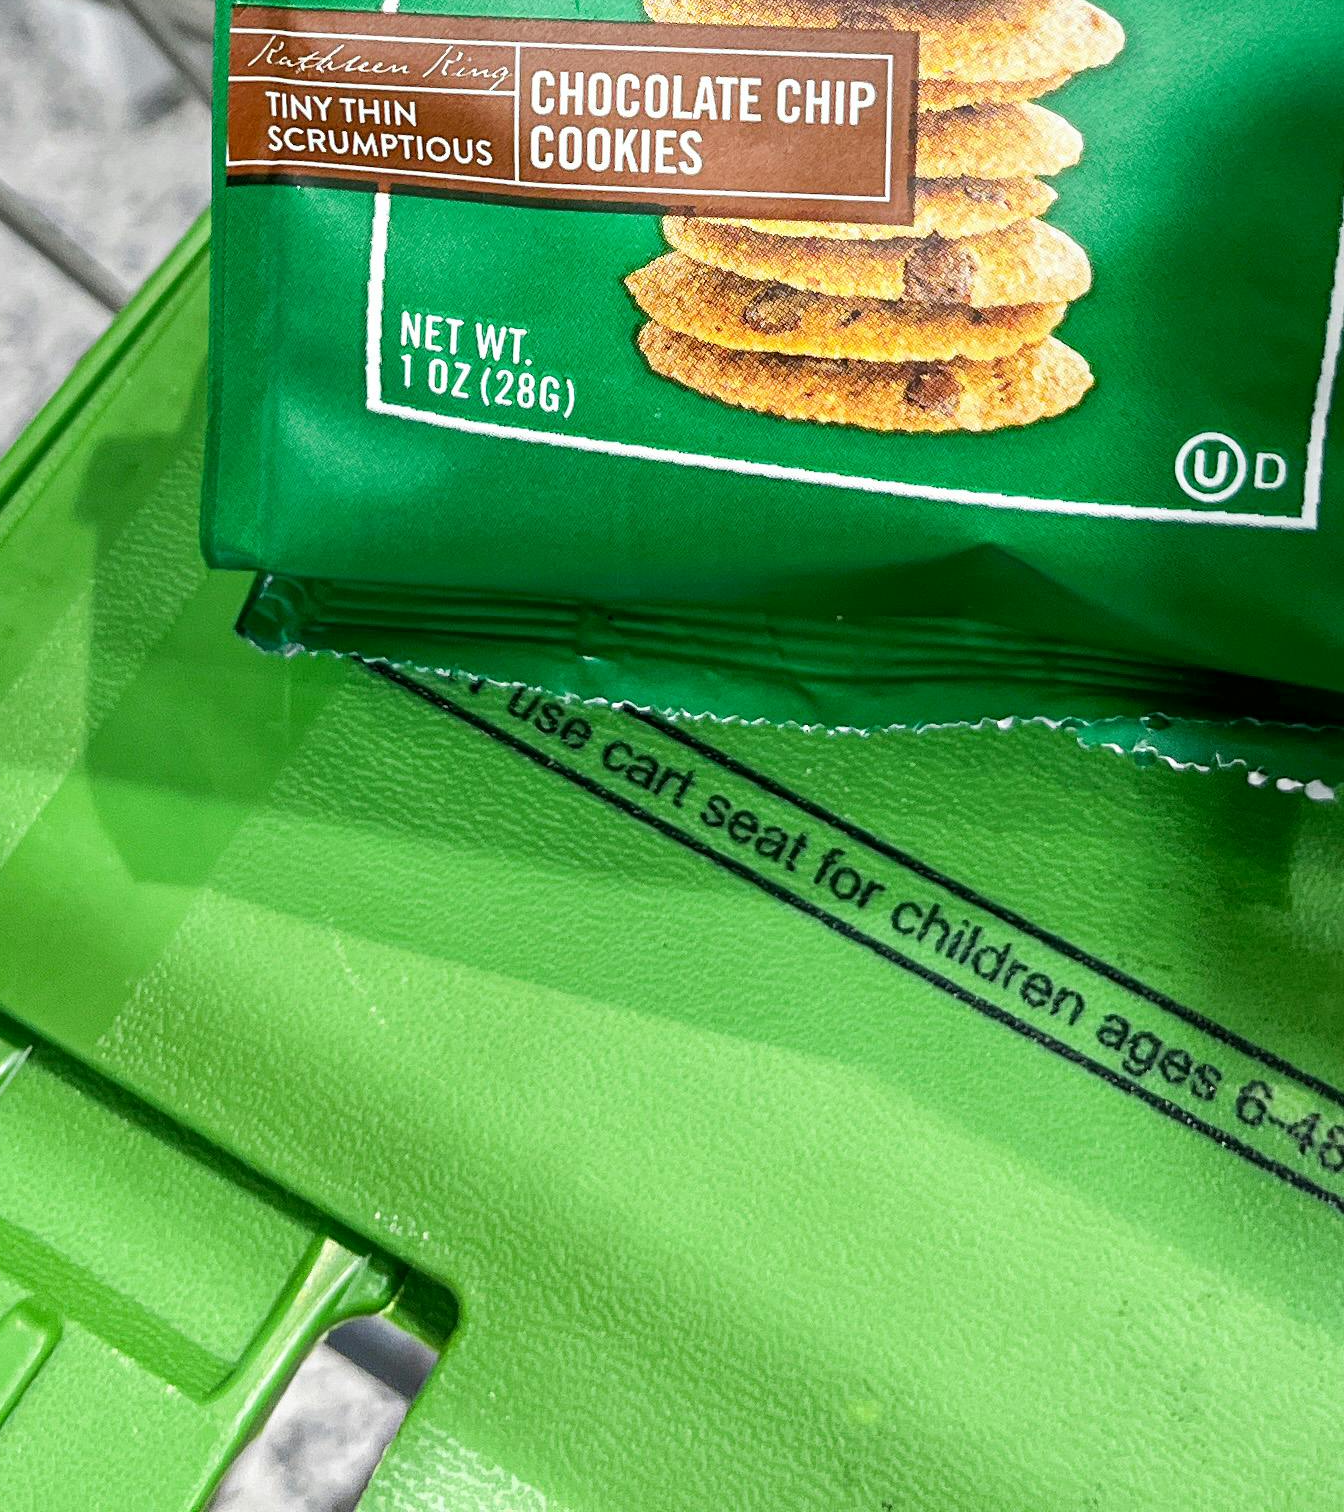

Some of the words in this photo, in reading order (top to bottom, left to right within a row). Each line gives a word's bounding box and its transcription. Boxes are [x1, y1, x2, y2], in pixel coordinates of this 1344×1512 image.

[247, 34, 411, 76] Kathleen
[421, 44, 513, 91] King
[264, 91, 334, 121] TINY
[338, 97, 418, 127] THIN
[530, 69, 763, 122] CHOCOLATE
[776, 78, 878, 126] CHIP
[267, 125, 495, 167] SCRUMPTIOUS
[529, 124, 705, 176] COOKIES
[400, 310, 465, 355] NET
[475, 322, 533, 367] WT.
[400, 353, 412, 389] 1
[428, 358, 472, 399] OZ
[480, 366, 575, 419] (28G)
[507, 687, 594, 750] use
[601, 738, 698, 810] cart
[698, 788, 809, 873] seat
[814, 846, 887, 910] for
[890, 896, 1087, 1026] children
[1094, 1008, 1224, 1104] ages
